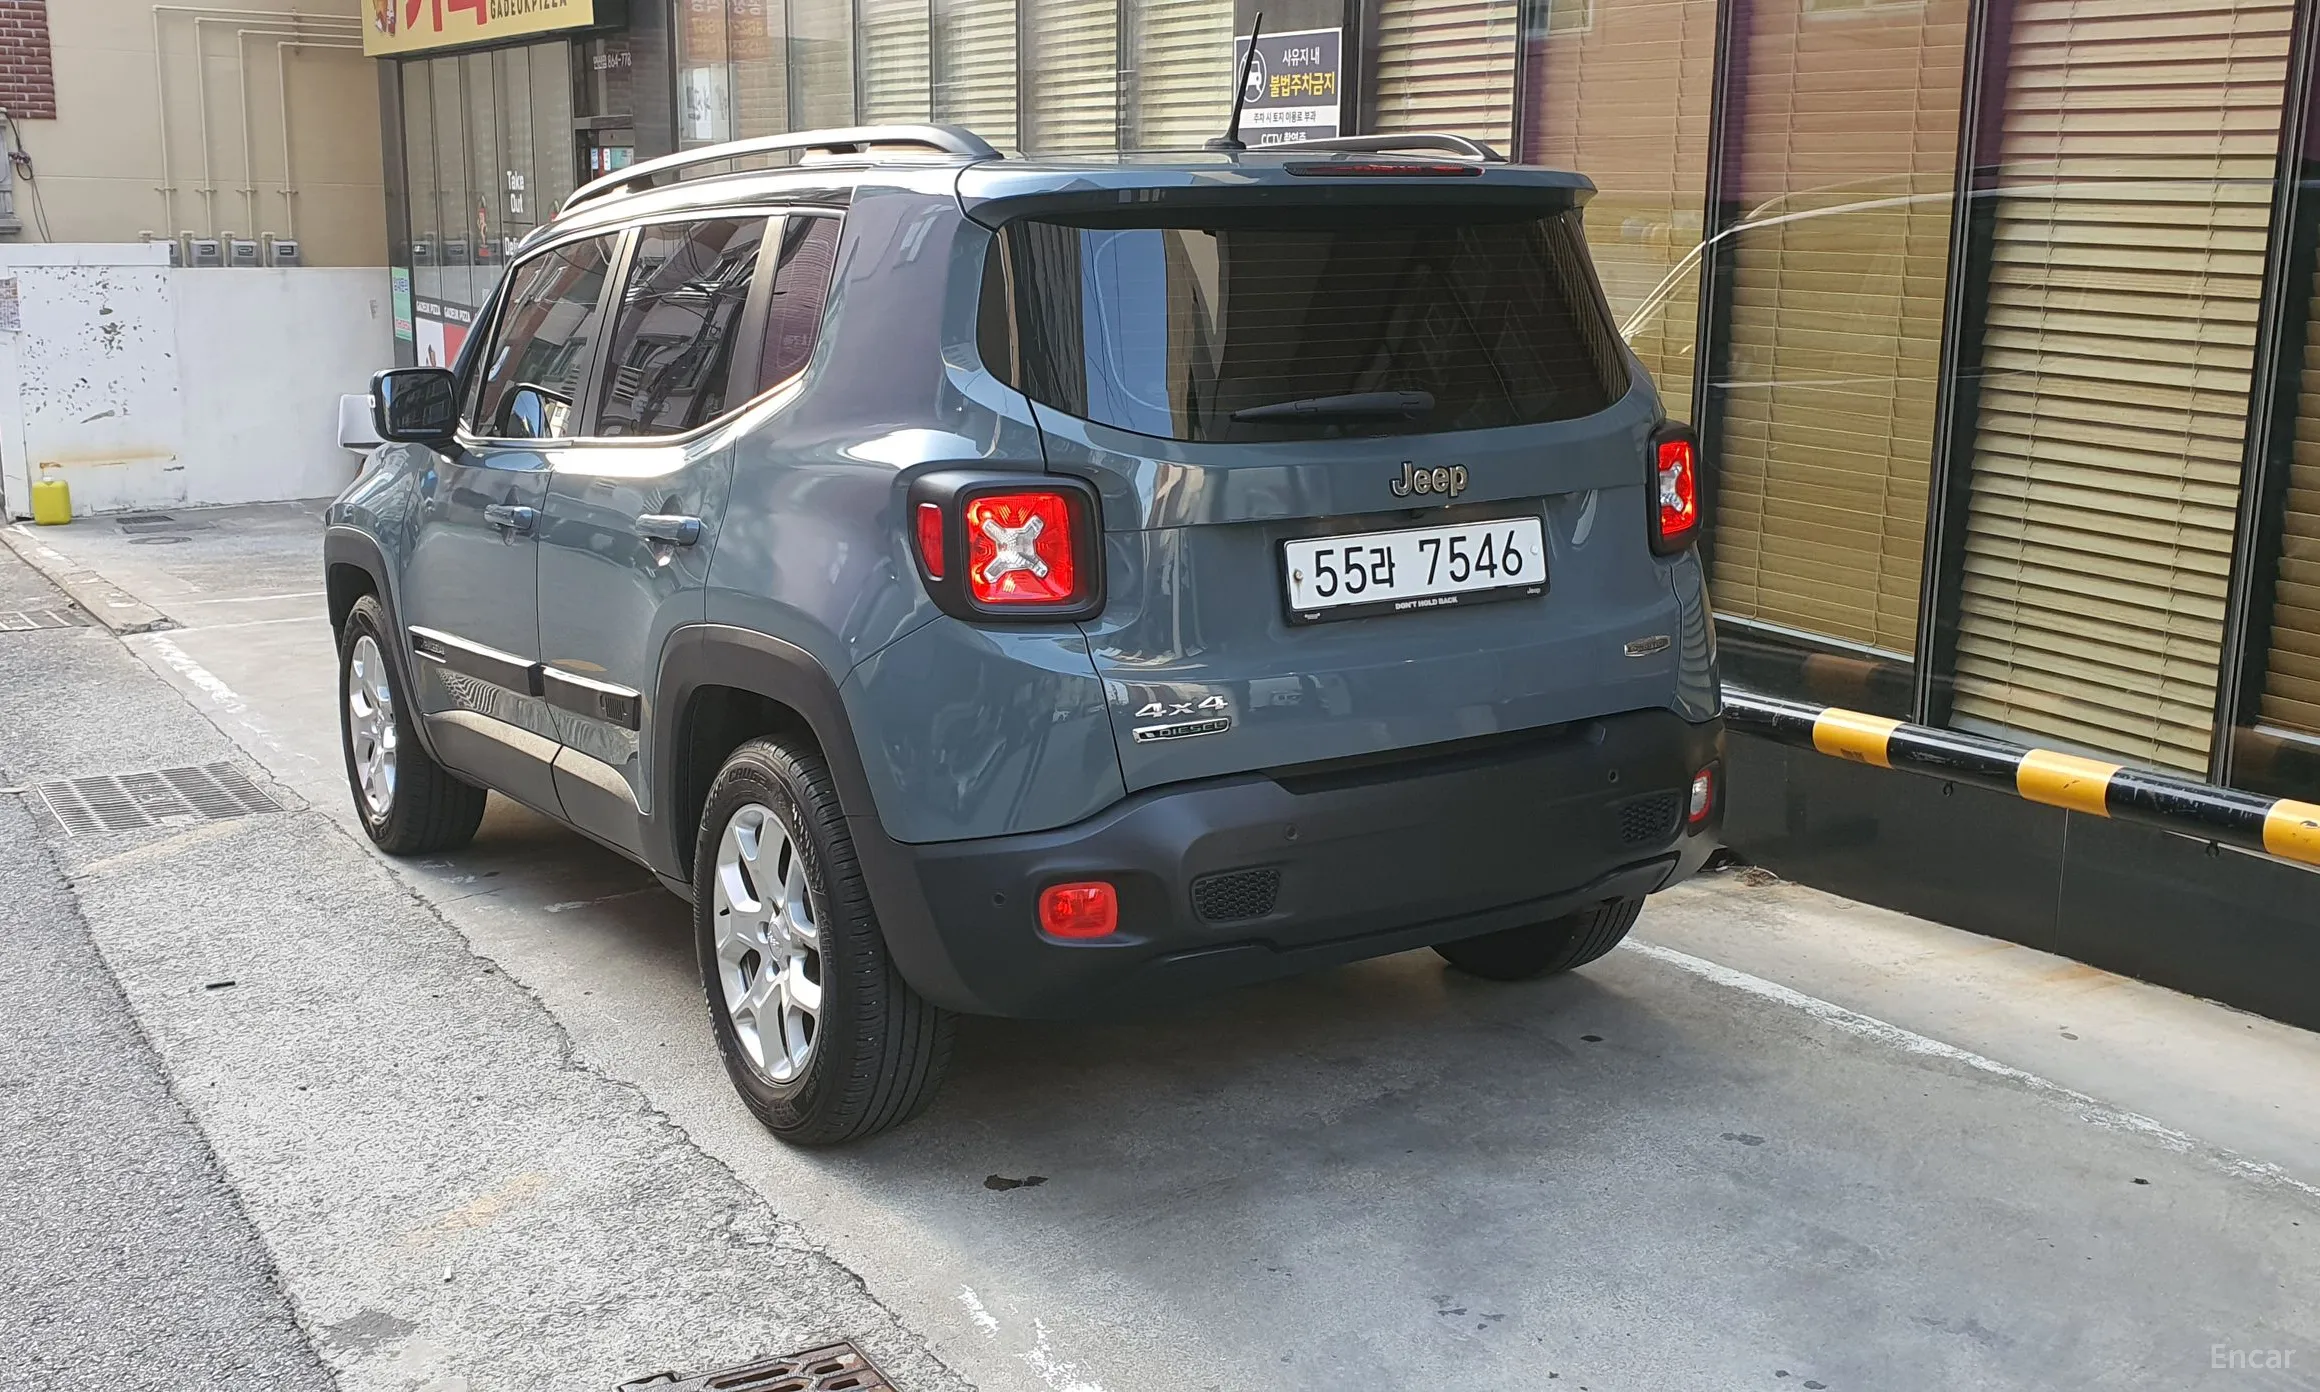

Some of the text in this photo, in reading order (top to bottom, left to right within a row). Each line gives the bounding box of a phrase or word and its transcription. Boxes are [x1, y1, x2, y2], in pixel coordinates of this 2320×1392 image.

[1282, 46, 1321, 67] 사유지 내
[1269, 71, 1335, 98] 불법주차금지
[1260, 133, 1283, 145] CCTV
[506, 170, 525, 191] Take
[510, 193, 524, 213] Out
[1389, 461, 1469, 498] Jeep
[1314, 530, 1523, 598] 55라 7546
[1395, 596, 1459, 611] DON'T HOLD BACK
[1159, 721, 1226, 737] DIESEL
